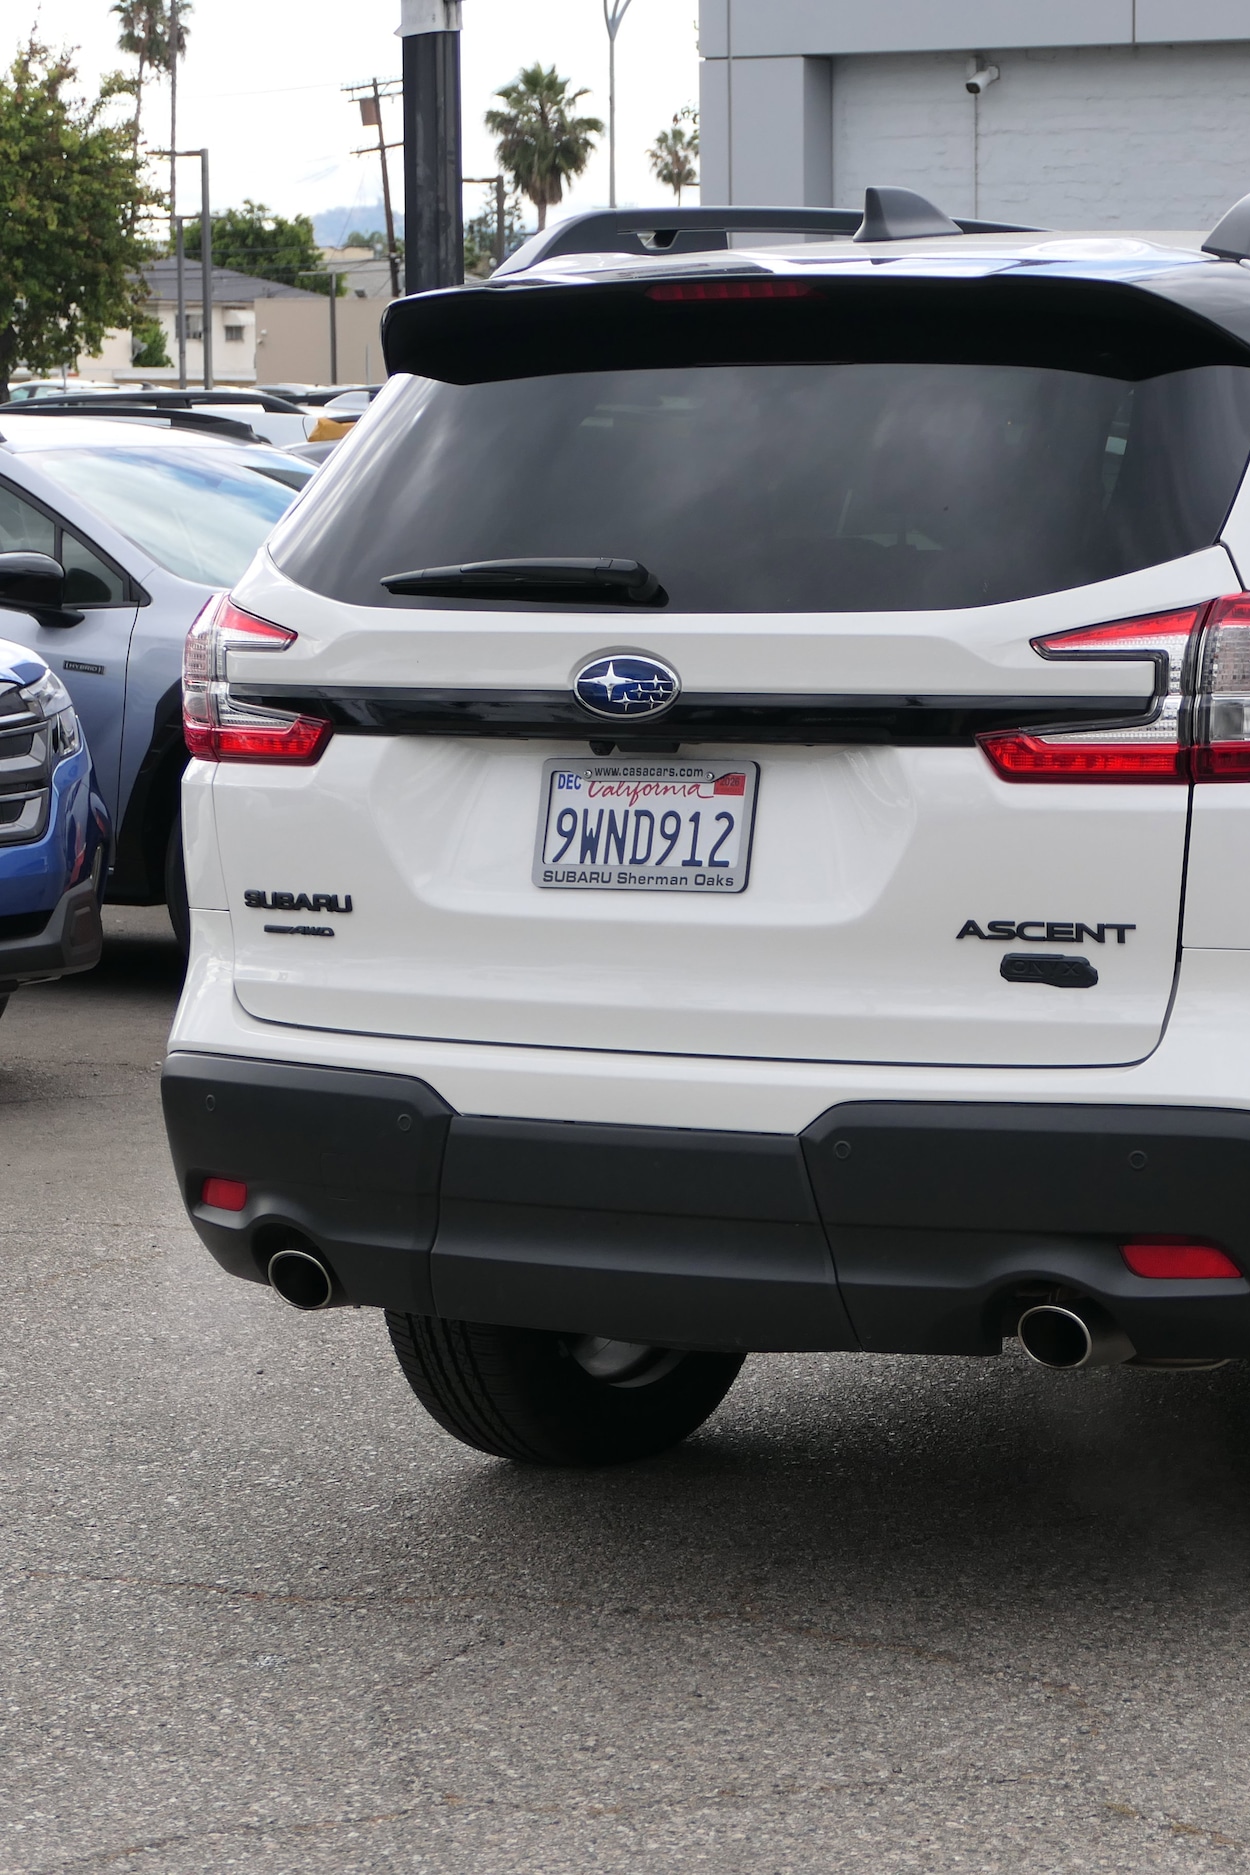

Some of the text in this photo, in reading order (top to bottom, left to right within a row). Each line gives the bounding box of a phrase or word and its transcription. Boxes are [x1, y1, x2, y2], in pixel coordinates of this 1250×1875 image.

[557, 773, 582, 791] DEC
[594, 766, 704, 778] www.casacars.com
[588, 781, 714, 807] California
[552, 807, 735, 868] 9WND912
[543, 870, 734, 887] SUBARU Sherman Oaks
[244, 889, 353, 912] SUBARU
[289, 925, 335, 936] AWD
[956, 919, 1137, 944] ASCENT
